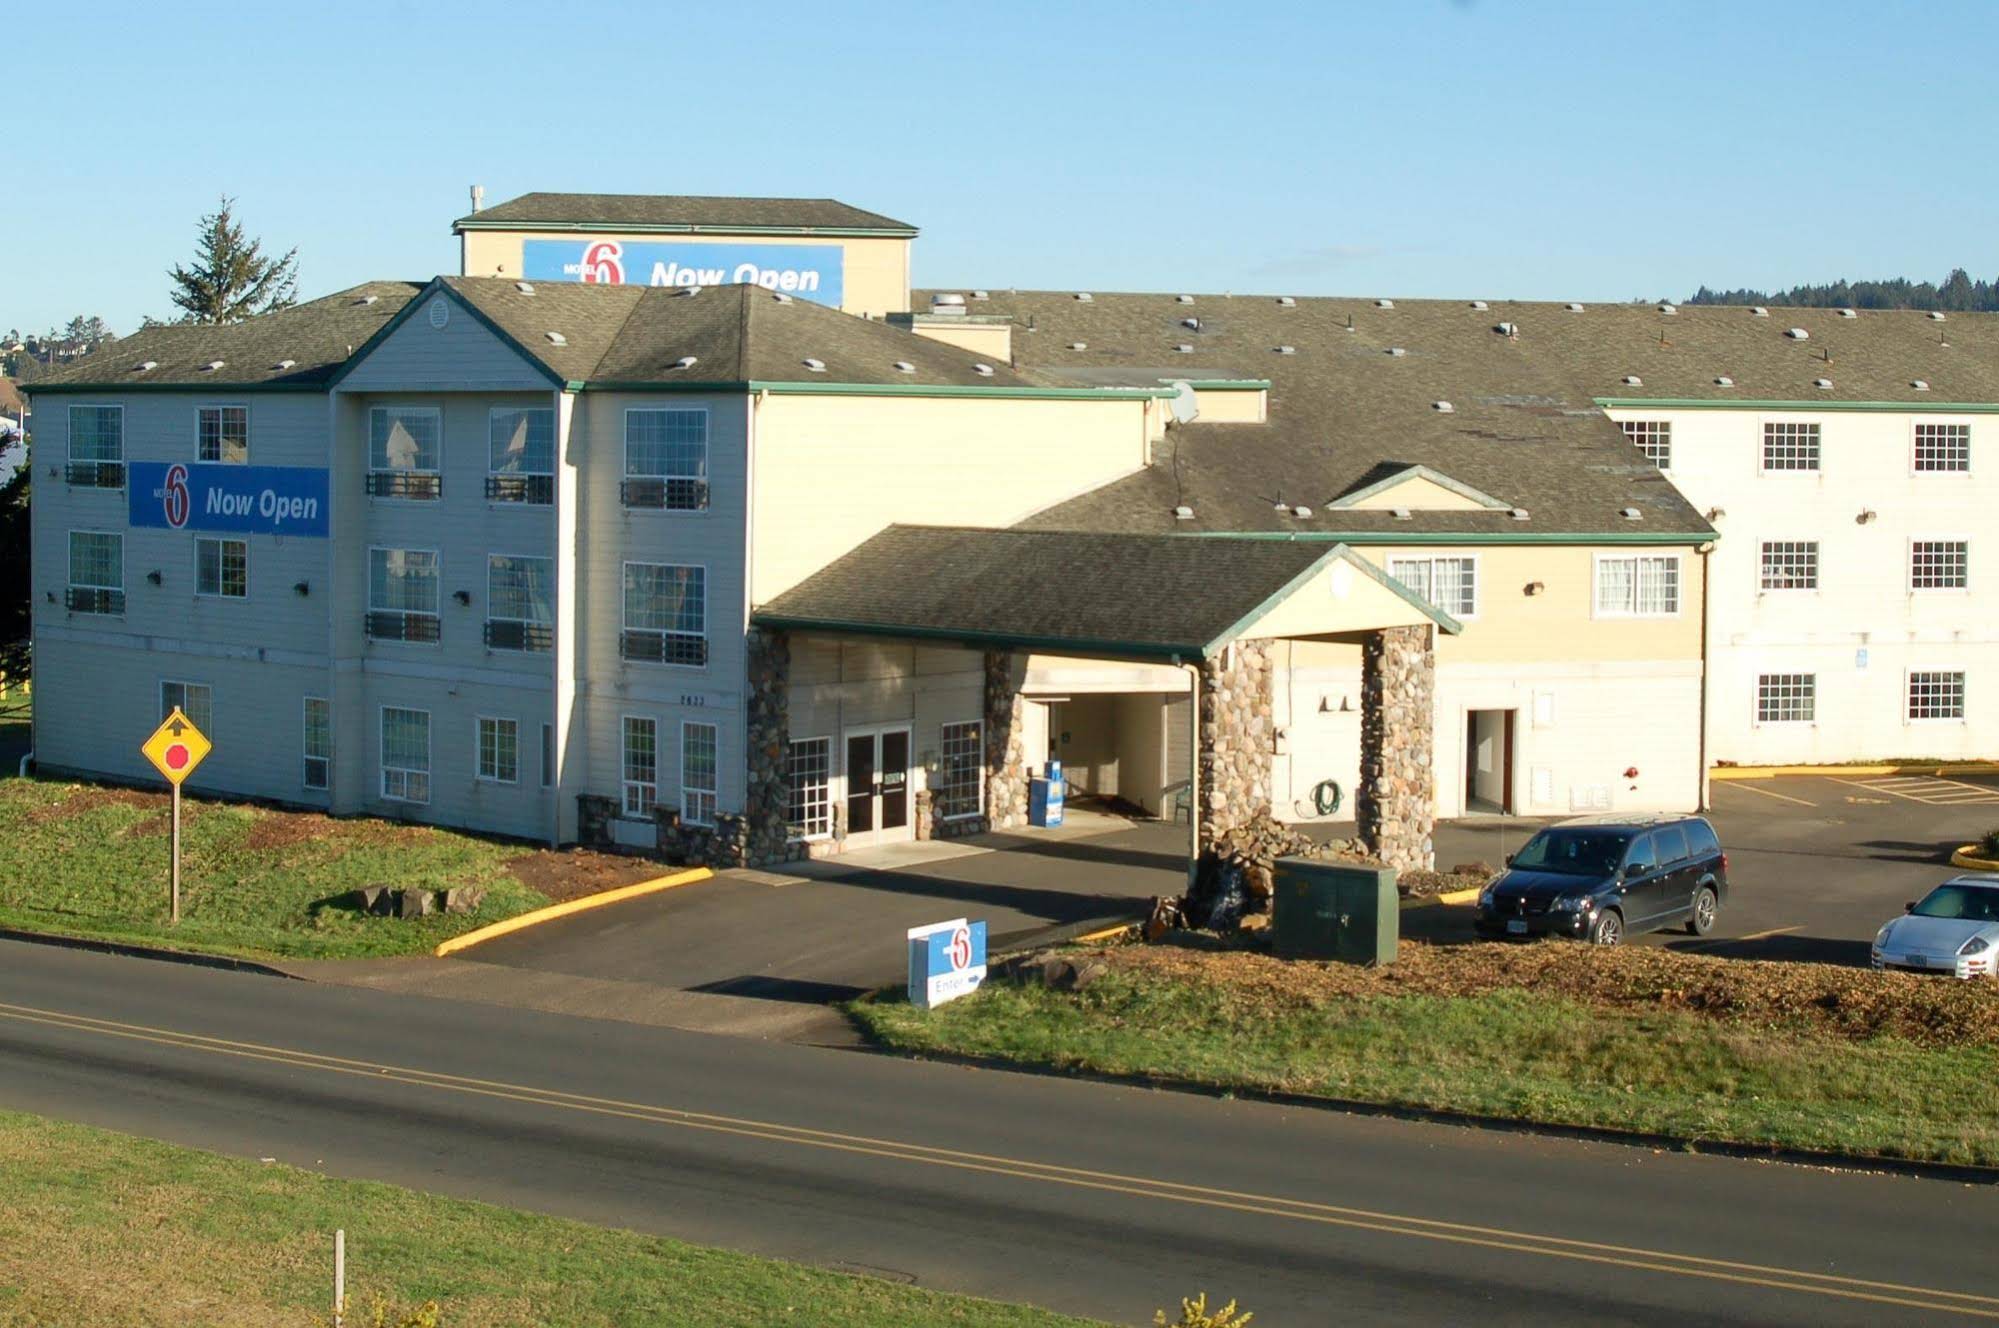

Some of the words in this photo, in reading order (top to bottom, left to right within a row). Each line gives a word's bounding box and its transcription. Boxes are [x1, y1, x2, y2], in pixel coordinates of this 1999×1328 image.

[581, 240, 625, 286] 6
[651, 262, 726, 287] Now
[733, 263, 819, 291] Open
[164, 463, 190, 528] 6
[206, 487, 253, 516] Now
[259, 489, 318, 525] Open
[950, 925, 972, 972] 6
